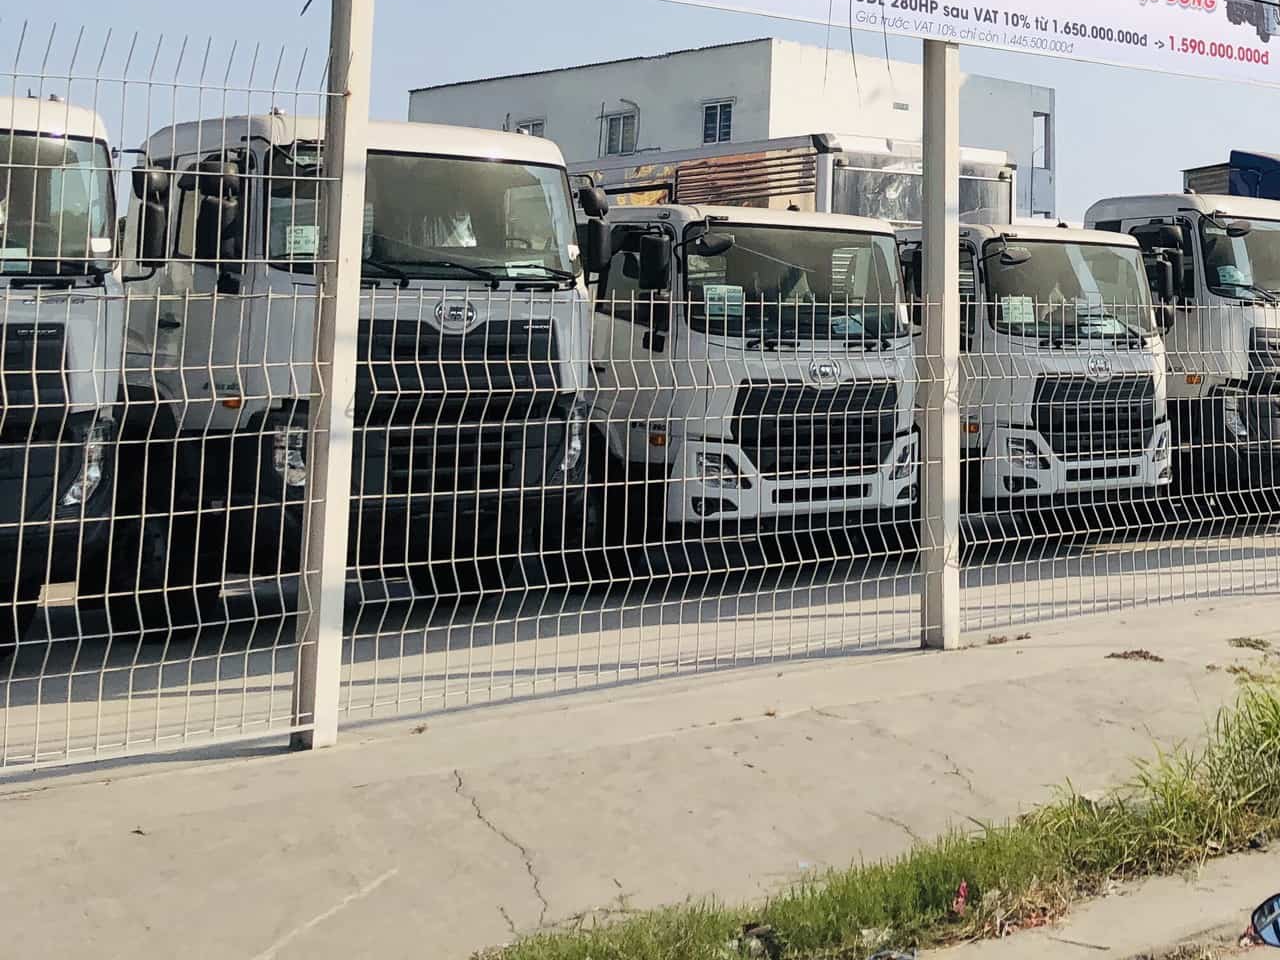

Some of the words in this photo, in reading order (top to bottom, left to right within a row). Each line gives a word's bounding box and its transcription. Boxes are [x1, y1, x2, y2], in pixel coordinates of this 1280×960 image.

[855, 10, 878, 26] Giá
[913, 19, 935, 34] VAT
[937, 23, 957, 38] 10%
[978, 28, 1001, 44] còn
[943, 2, 970, 21] sau
[973, 6, 1000, 26] VAT
[1003, 11, 1031, 31] 10%
[1034, 15, 1050, 34] từ
[1052, 18, 1148, 48] 1.650.000.000đ
[1168, 34, 1270, 66] 1.590.000.000đ
